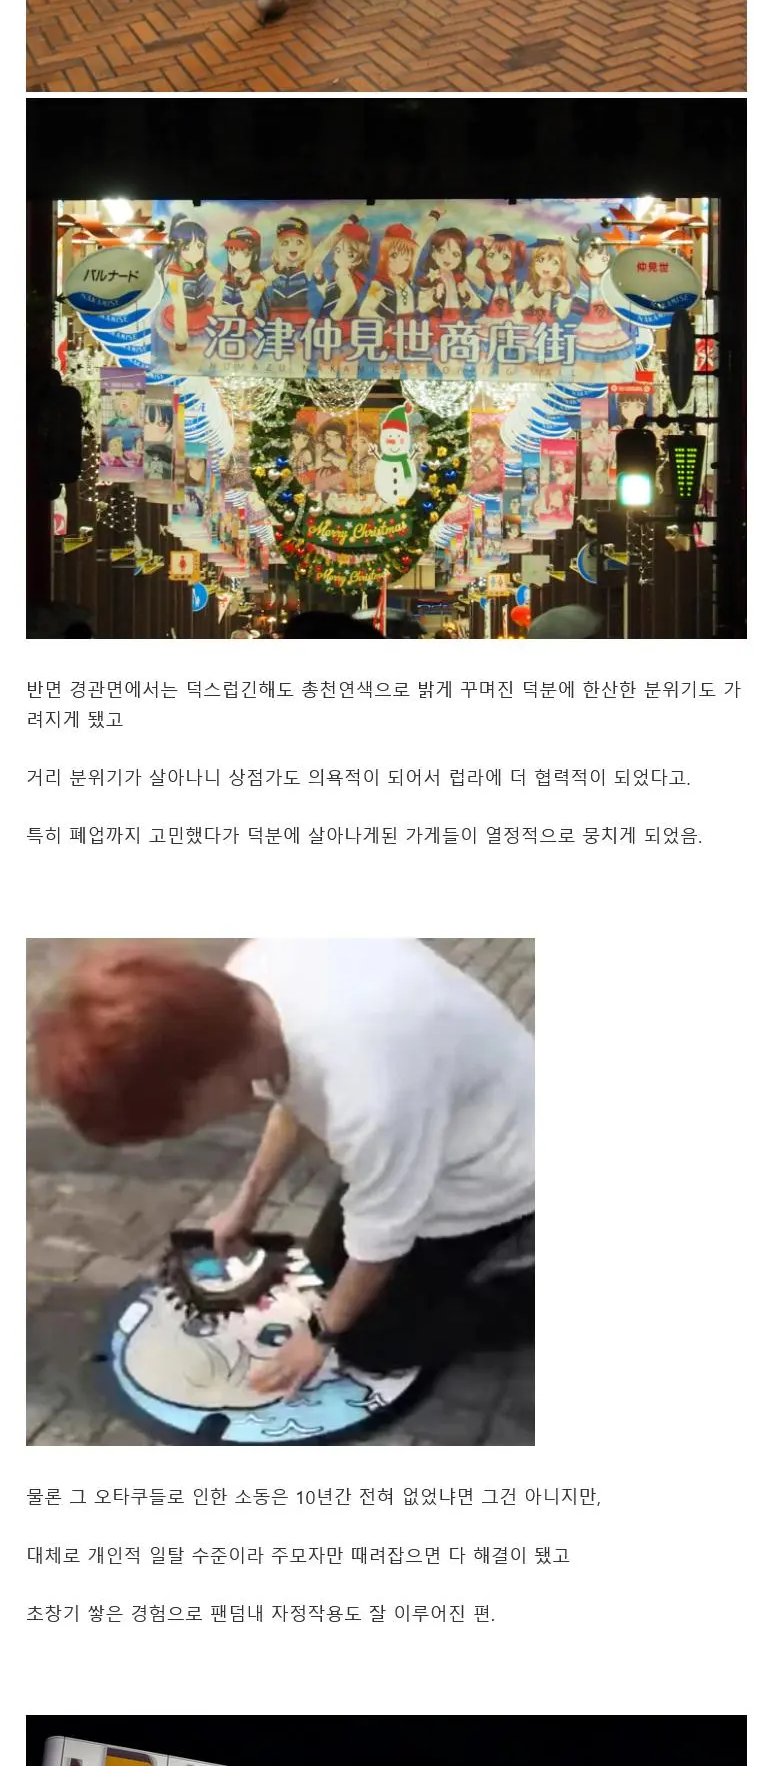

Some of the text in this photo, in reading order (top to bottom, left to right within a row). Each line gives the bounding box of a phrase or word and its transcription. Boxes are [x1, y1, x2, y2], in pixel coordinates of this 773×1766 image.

[637, 262, 669, 273] 仲見世
[204, 315, 578, 366] 沼津仲見世商店街
[309, 521, 349, 545] Merry
